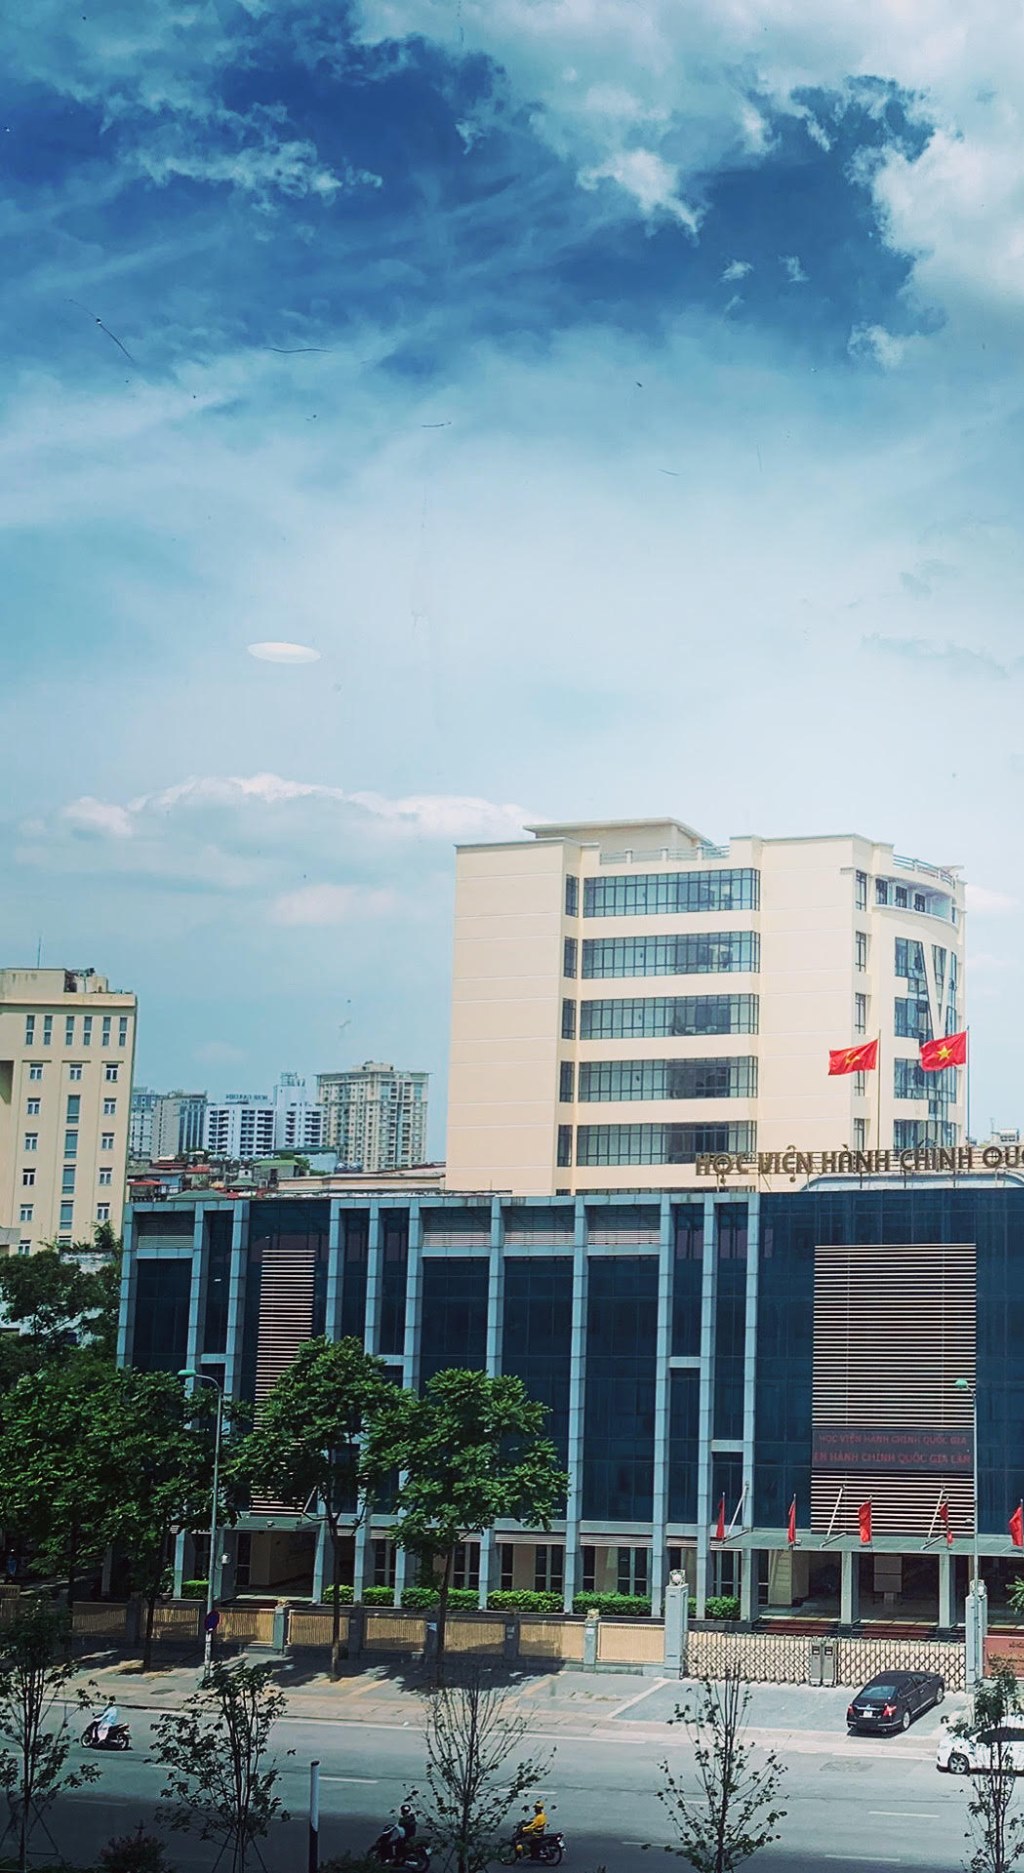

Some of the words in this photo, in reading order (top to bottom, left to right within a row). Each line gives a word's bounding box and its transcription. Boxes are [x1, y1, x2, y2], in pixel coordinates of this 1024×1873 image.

[696, 1152, 749, 1185] HỌC
[757, 1144, 815, 1183] VIỆN
[821, 1143, 891, 1173] HÀNH
[900, 1138, 973, 1171] CHÍNH
